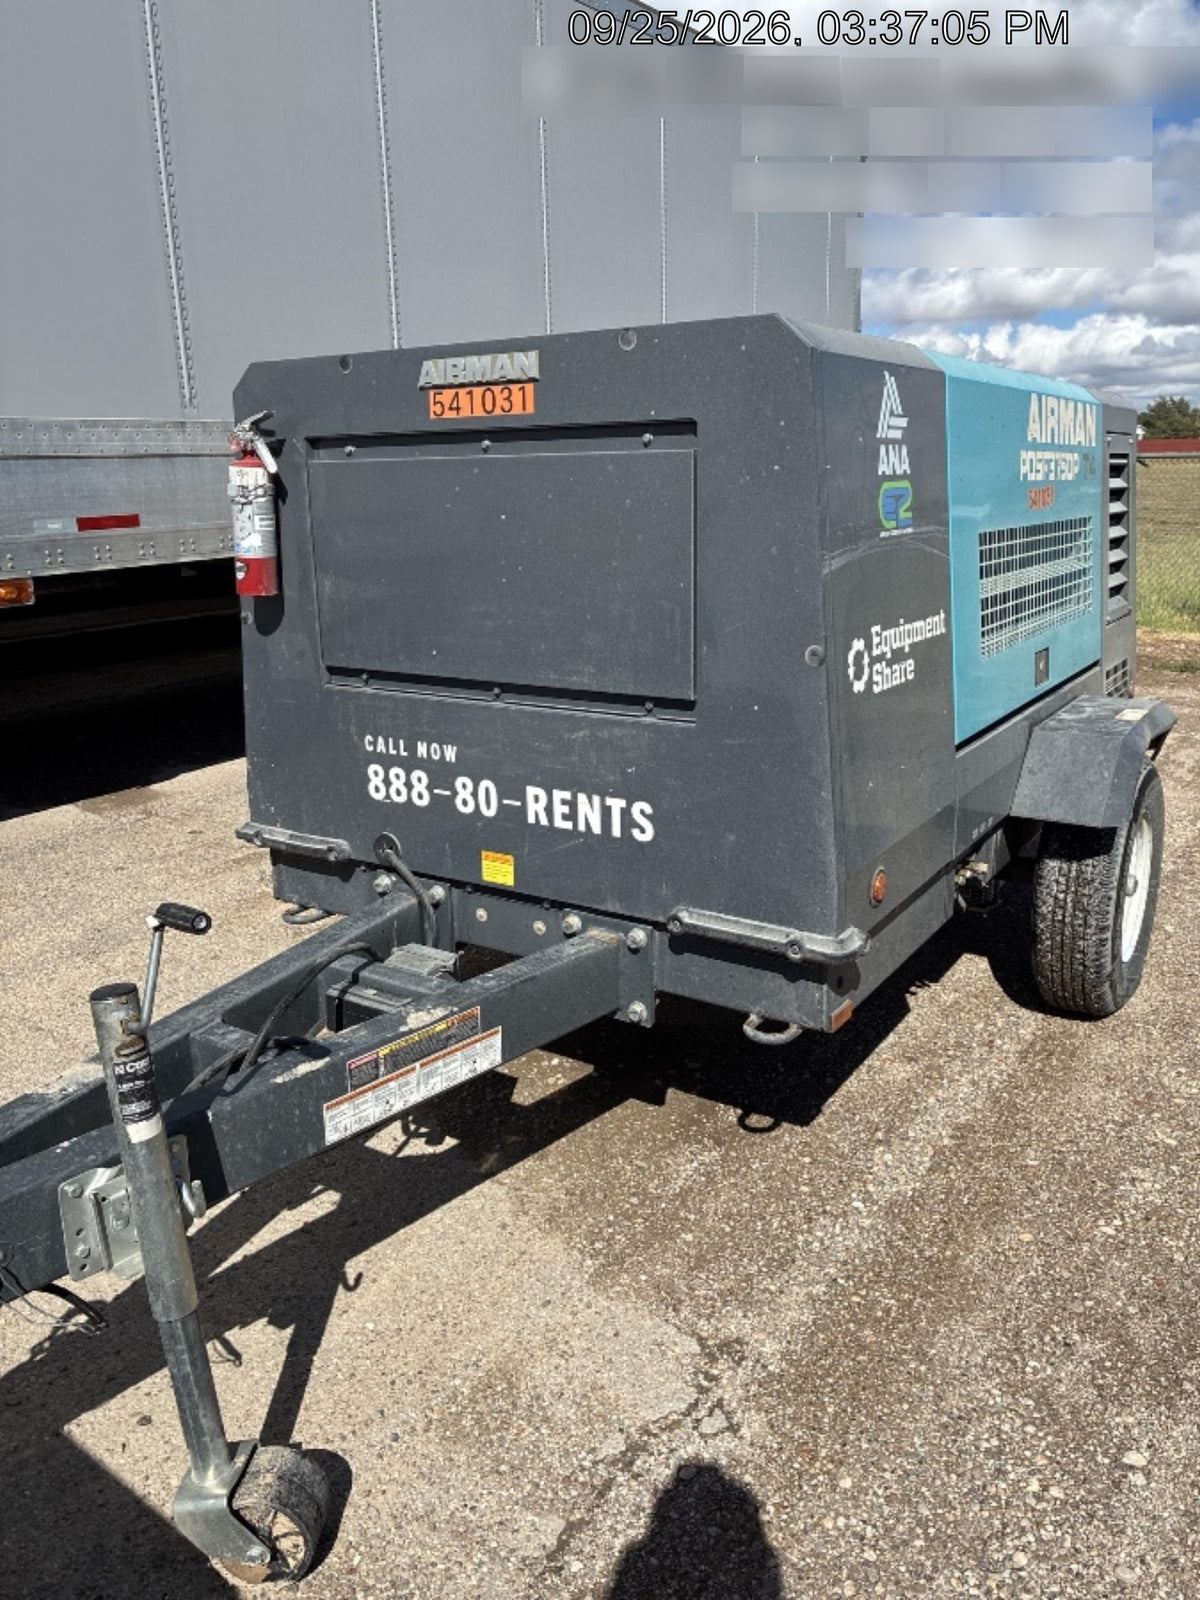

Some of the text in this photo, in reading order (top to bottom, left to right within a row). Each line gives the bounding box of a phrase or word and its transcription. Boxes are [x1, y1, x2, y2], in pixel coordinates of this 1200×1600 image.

[418, 350, 539, 388] AIRMAN
[432, 385, 527, 417] 541031
[1027, 392, 1097, 447] AIRMAN
[878, 443, 911, 475] ANA
[871, 609, 946, 659] Equipment
[872, 658, 915, 694] Share
[364, 734, 458, 763] CALL NOW
[367, 763, 655, 842] 888-80-RENTS
